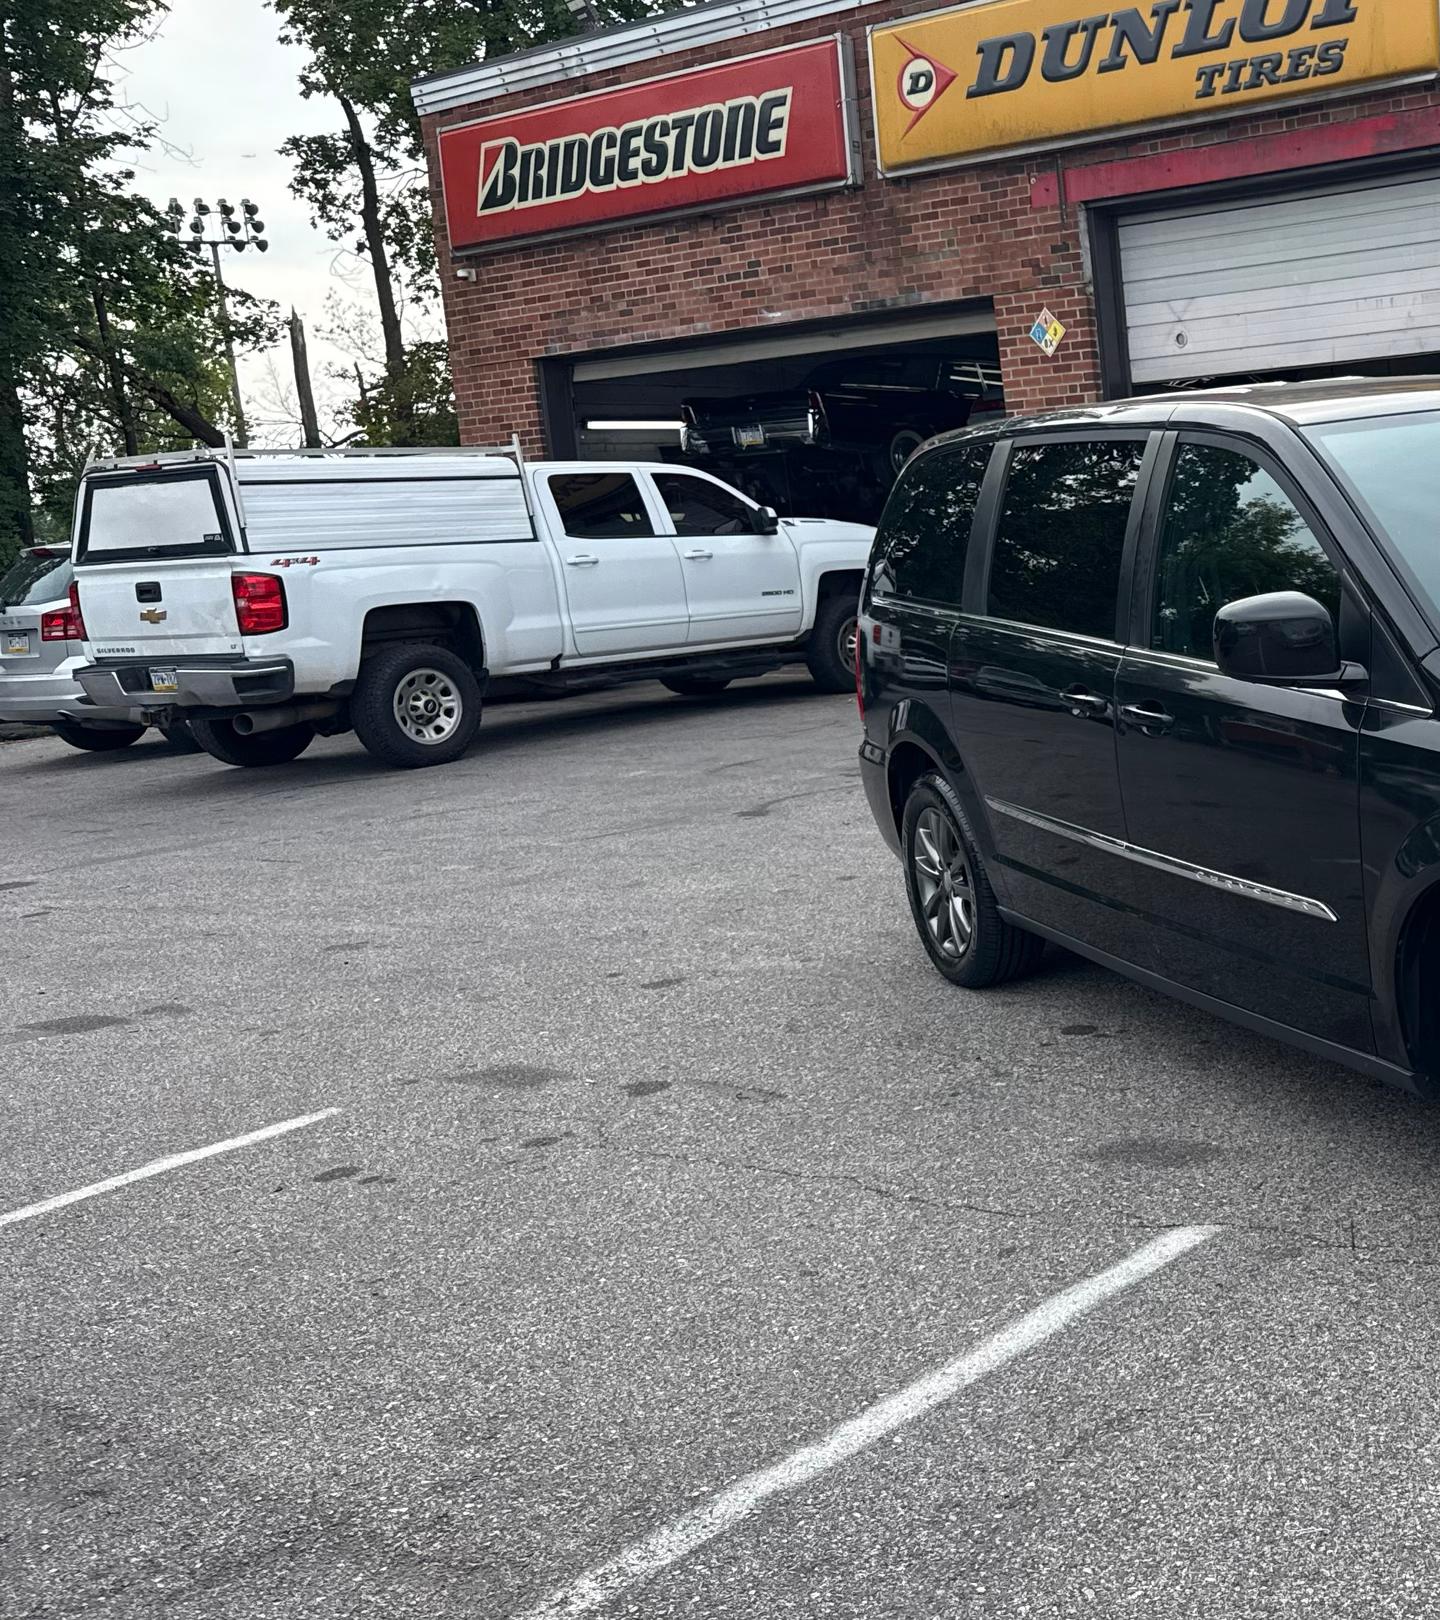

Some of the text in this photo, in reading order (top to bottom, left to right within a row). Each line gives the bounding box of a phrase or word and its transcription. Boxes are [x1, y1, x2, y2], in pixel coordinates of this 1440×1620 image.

[907, 69, 934, 96] D
[1194, 38, 1349, 99] TIRES
[479, 93, 788, 212] BRIDGESTONE
